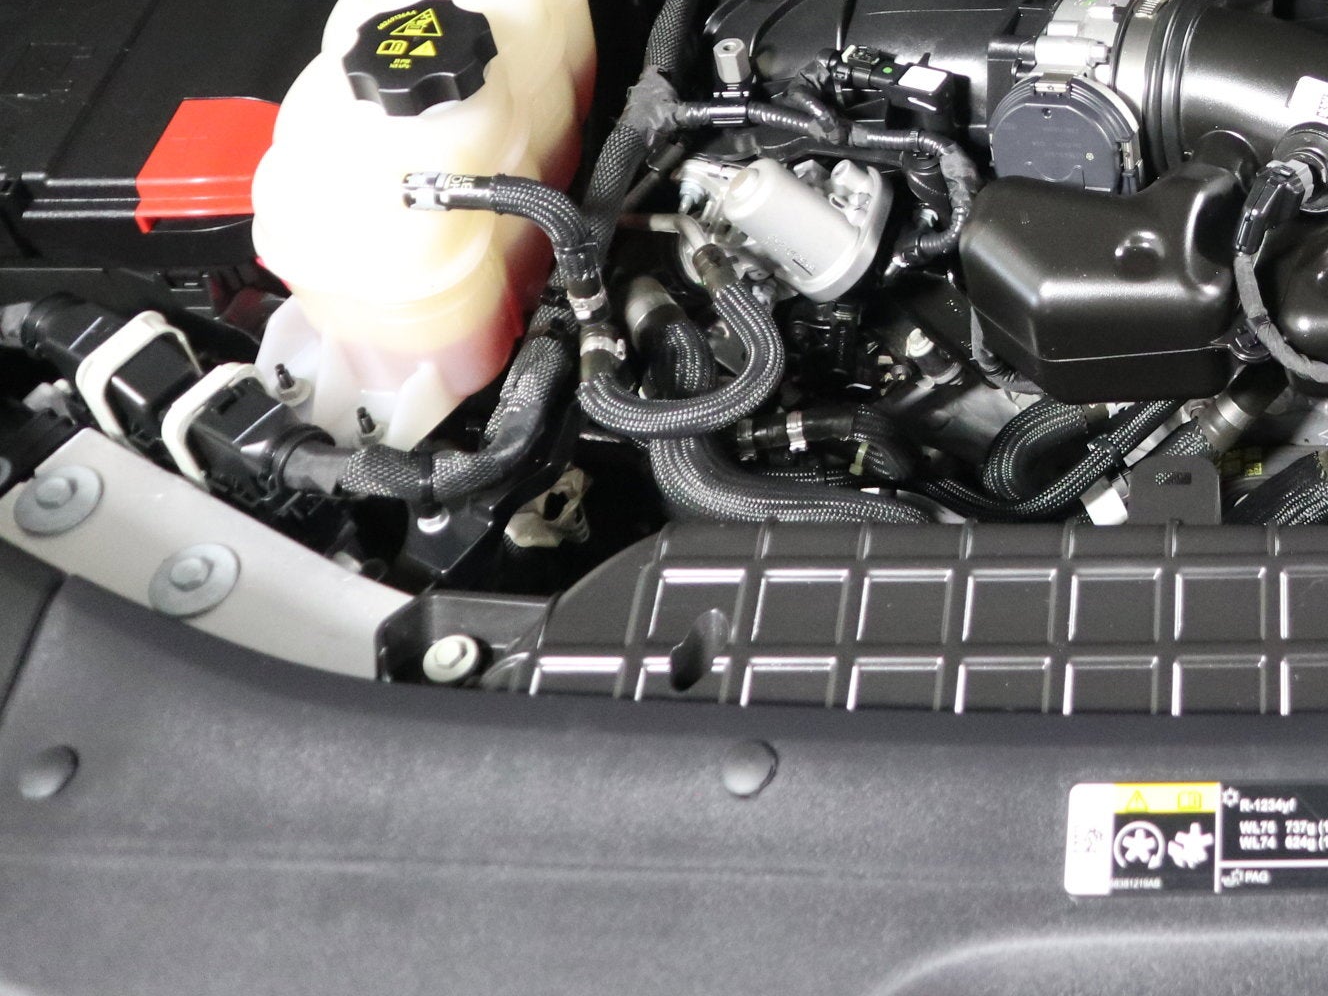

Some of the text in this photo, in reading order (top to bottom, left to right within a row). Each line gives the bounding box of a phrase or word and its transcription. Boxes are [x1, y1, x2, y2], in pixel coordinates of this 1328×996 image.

[1240, 797, 1297, 815] R-1234yf
[1285, 819, 1317, 837] 737g
[1239, 835, 1277, 850] WL74
